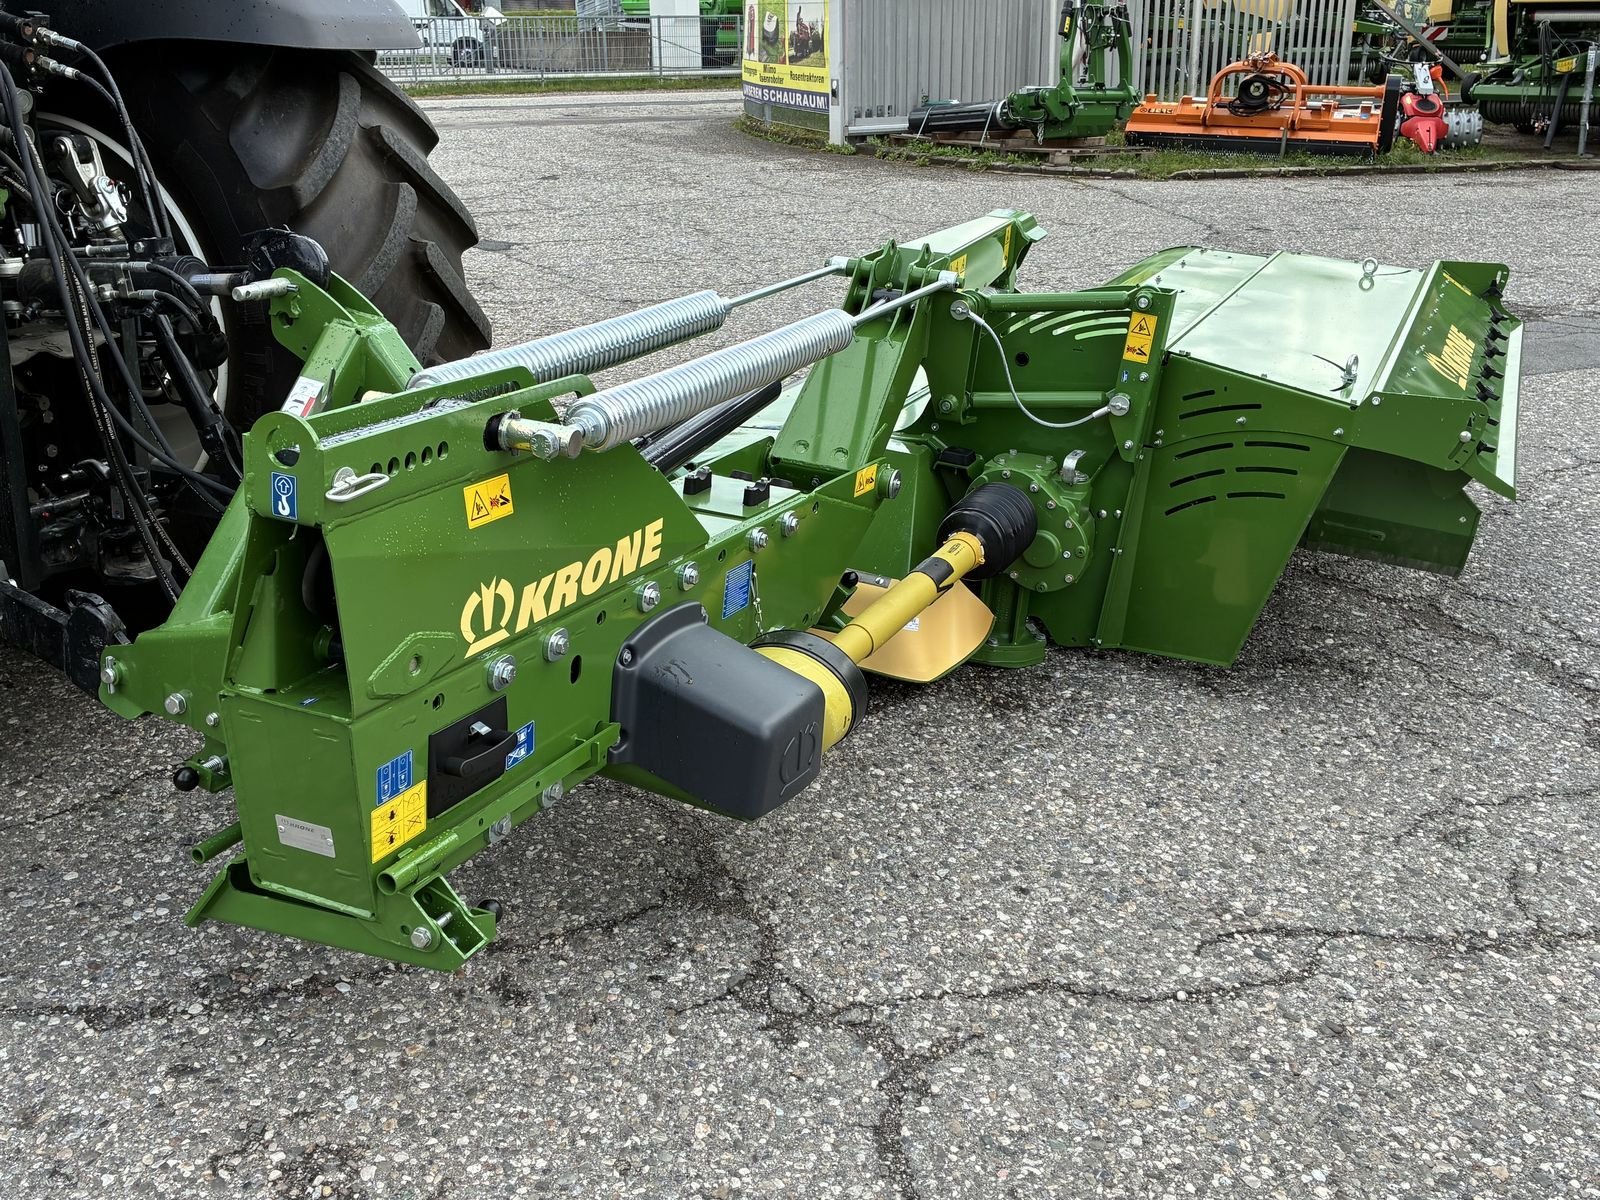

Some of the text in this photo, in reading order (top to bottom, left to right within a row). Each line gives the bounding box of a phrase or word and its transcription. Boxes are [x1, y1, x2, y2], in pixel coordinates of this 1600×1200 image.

[790, 71, 824, 84] Rasentraktoren
[763, 88, 828, 109] SCHAURAUM!
[515, 517, 664, 633] KRONE
